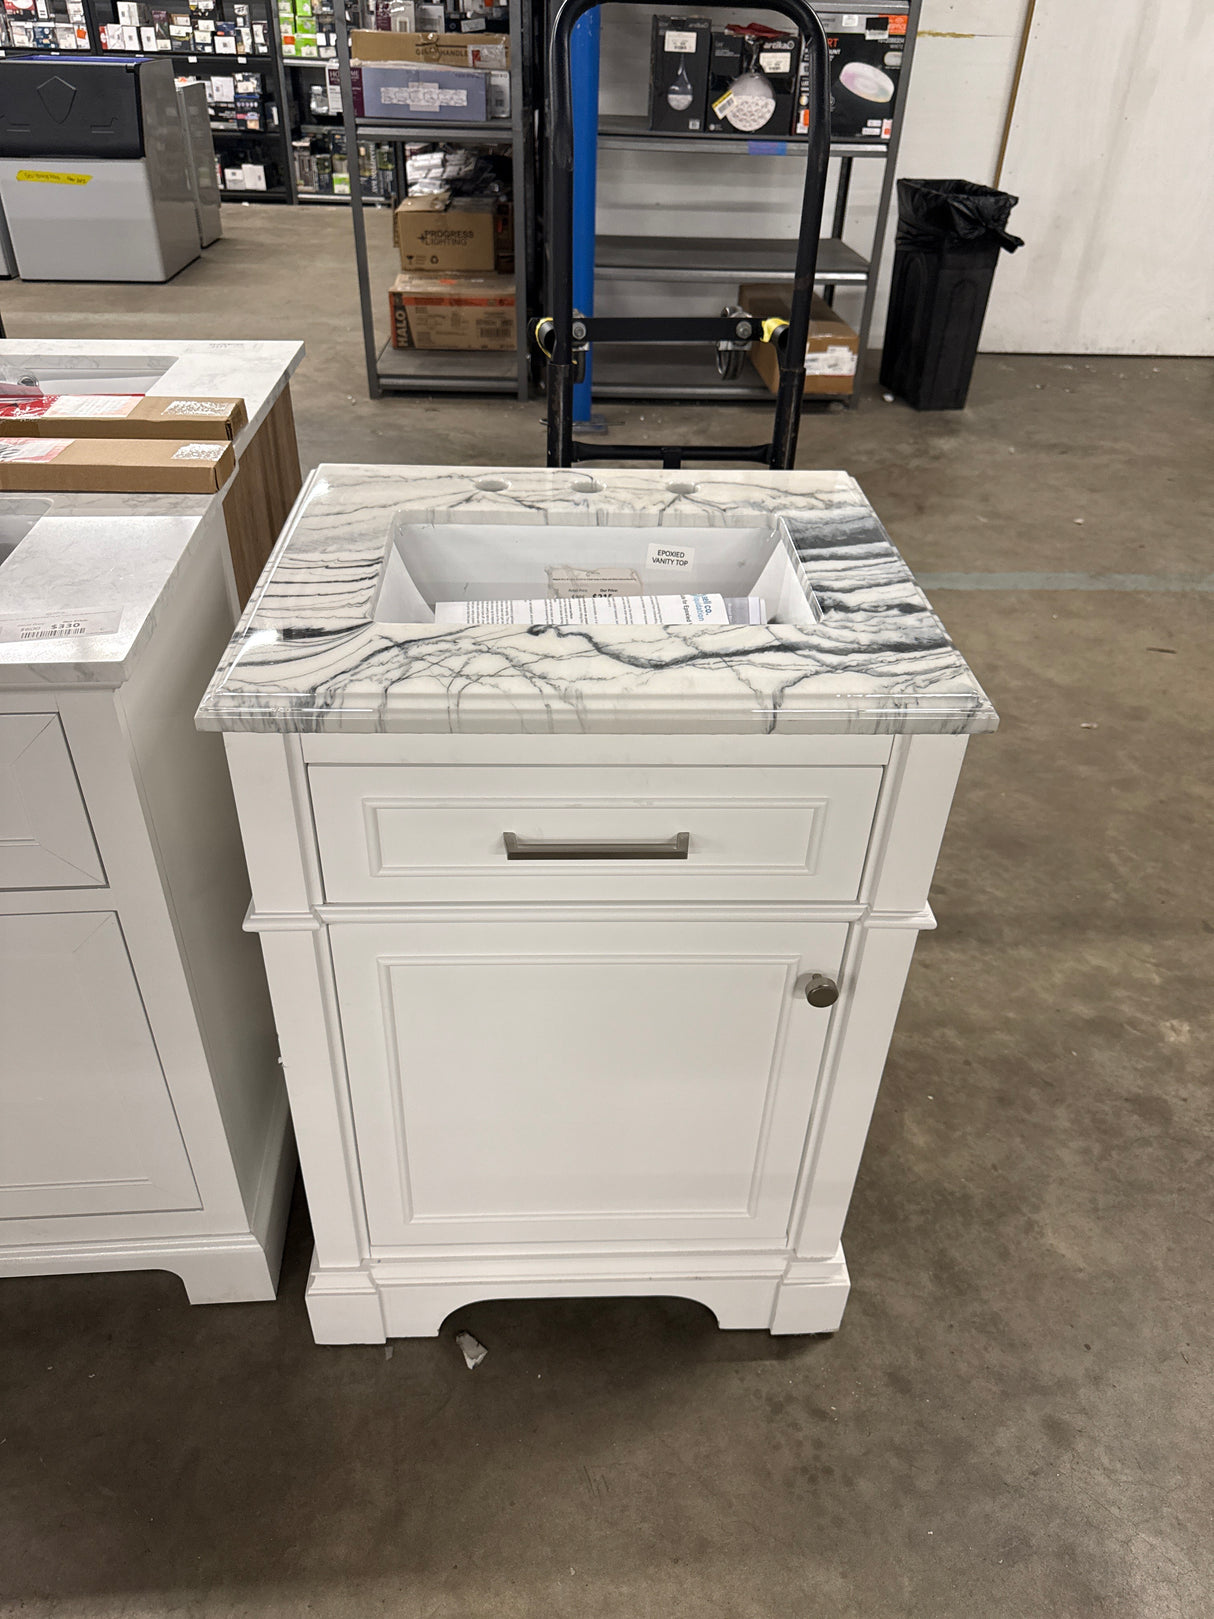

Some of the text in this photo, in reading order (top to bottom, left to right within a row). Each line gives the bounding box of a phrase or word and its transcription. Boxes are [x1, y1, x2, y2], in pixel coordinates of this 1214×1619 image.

[424, 230, 474, 240] PROGRESS
[425, 238, 468, 247] LIGHTING
[395, 309, 409, 348] HALO
[657, 549, 686, 559] EPOXIED
[651, 556, 689, 567] VANITY TOP
[51, 622, 80, 630] $330
